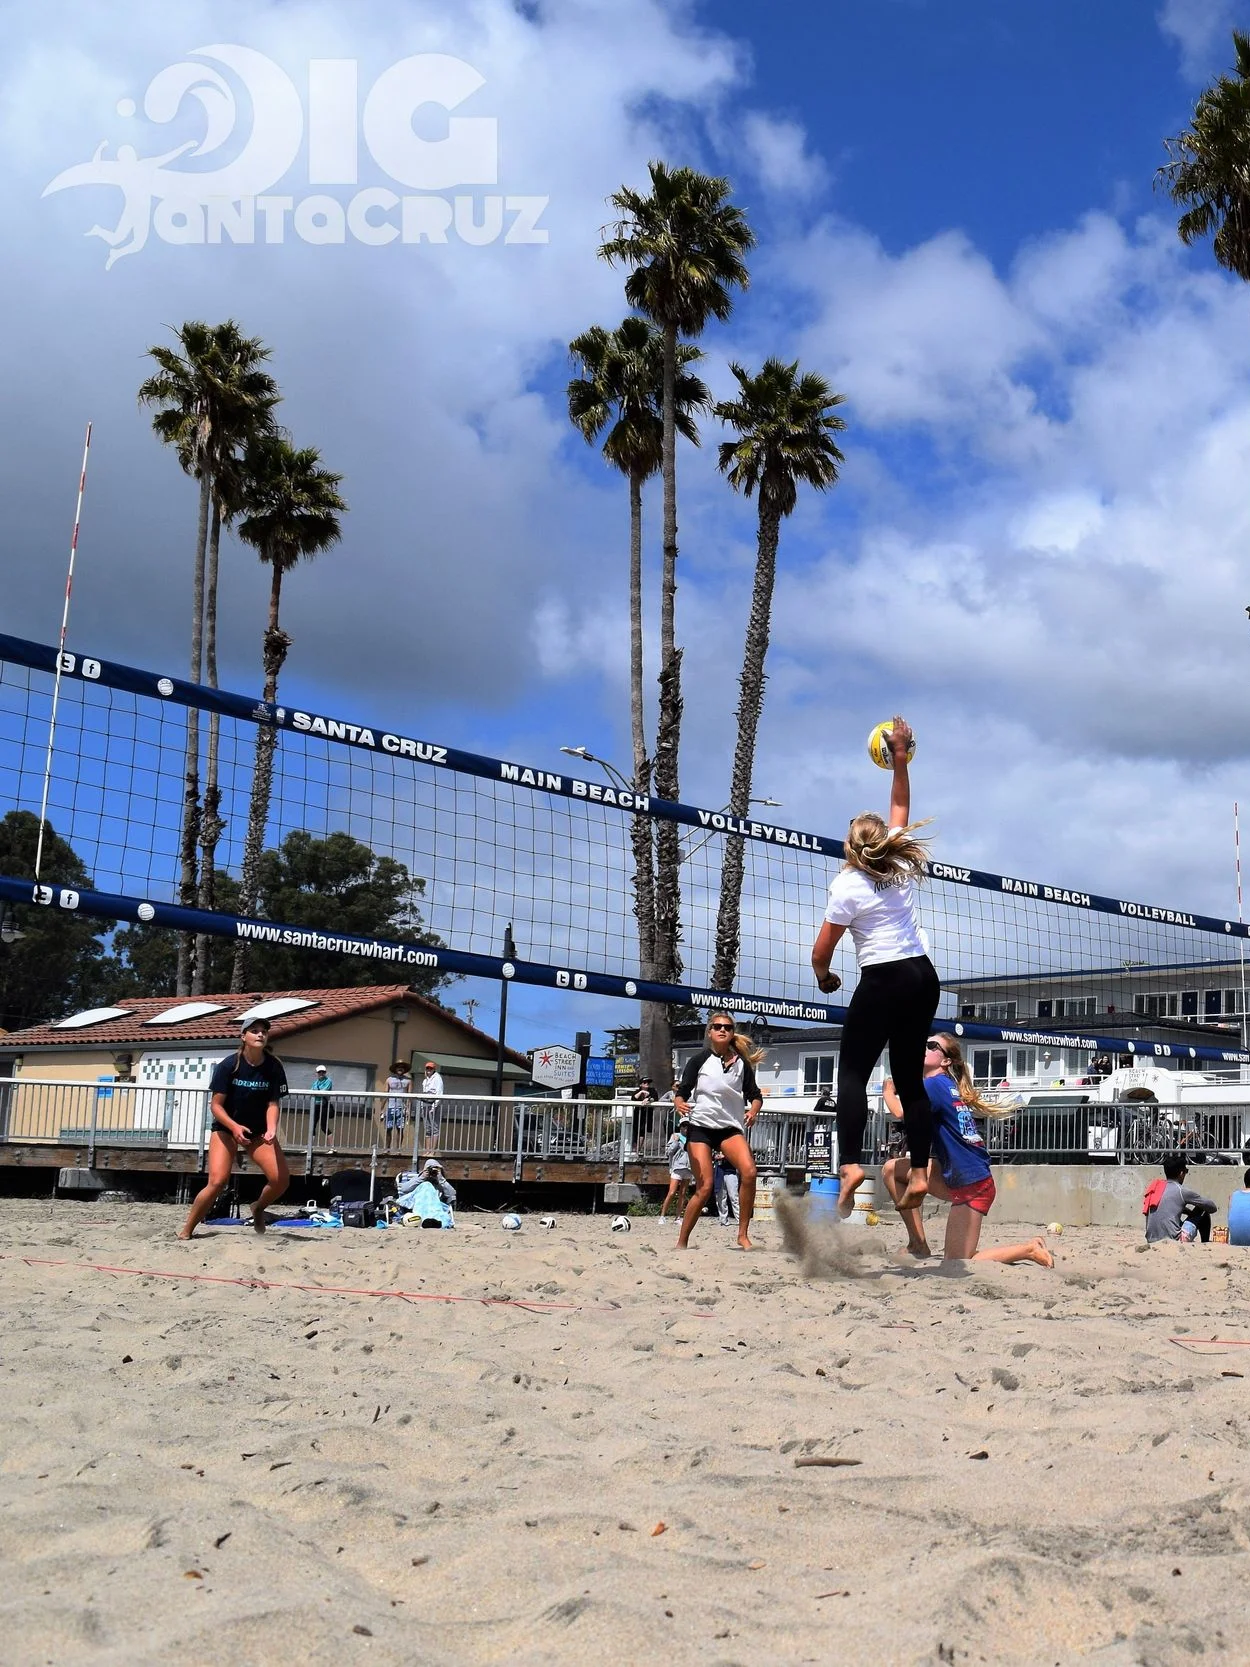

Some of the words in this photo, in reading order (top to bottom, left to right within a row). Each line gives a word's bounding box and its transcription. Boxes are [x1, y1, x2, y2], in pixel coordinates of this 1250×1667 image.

[292, 711, 376, 747] SANTA
[381, 734, 448, 764] CRUZ
[500, 763, 562, 791] MAIN
[571, 779, 650, 811] BEACH
[697, 810, 823, 851] VOLLEYBALL
[932, 863, 971, 883] CRUZ
[1001, 877, 1039, 897] MAIN
[1043, 886, 1091, 907] BEACH
[1118, 901, 1197, 927] VOLLEYBALL
[236, 922, 438, 968] www.santacruzwharf.com
[690, 992, 827, 1021] www.santacruzwharf.com
[554, 1052, 577, 1060] BEACH
[1001, 1030, 1098, 1050] www.santacruzwharf.com
